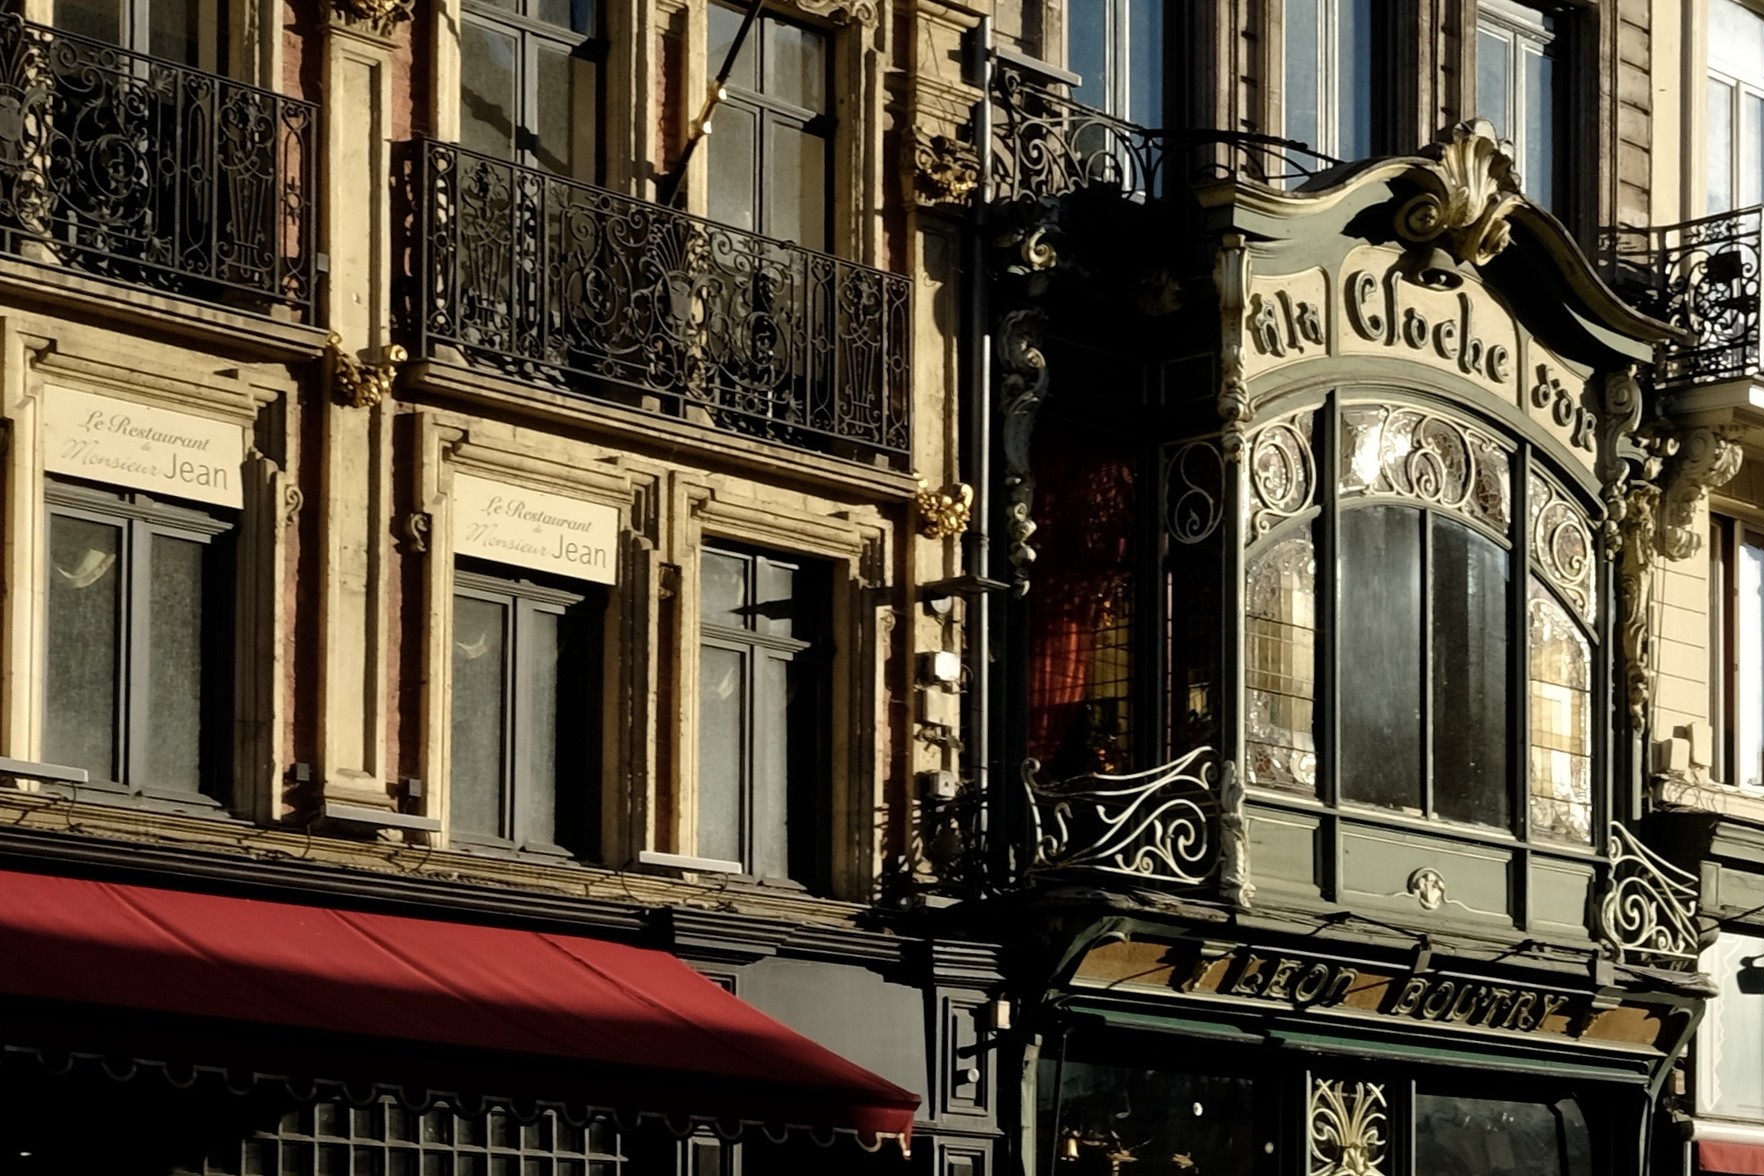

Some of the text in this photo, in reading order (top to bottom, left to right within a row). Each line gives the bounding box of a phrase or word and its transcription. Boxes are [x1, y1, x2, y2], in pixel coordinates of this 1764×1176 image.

[1343, 268, 1511, 384] Cloche
[78, 410, 210, 451] Le Restaurant
[61, 438, 228, 490] Monsieur Jean
[480, 496, 592, 533] Le Restaurant
[465, 522, 606, 569] Monsieur Jean
[1393, 977, 1570, 1031] BOUTRY
